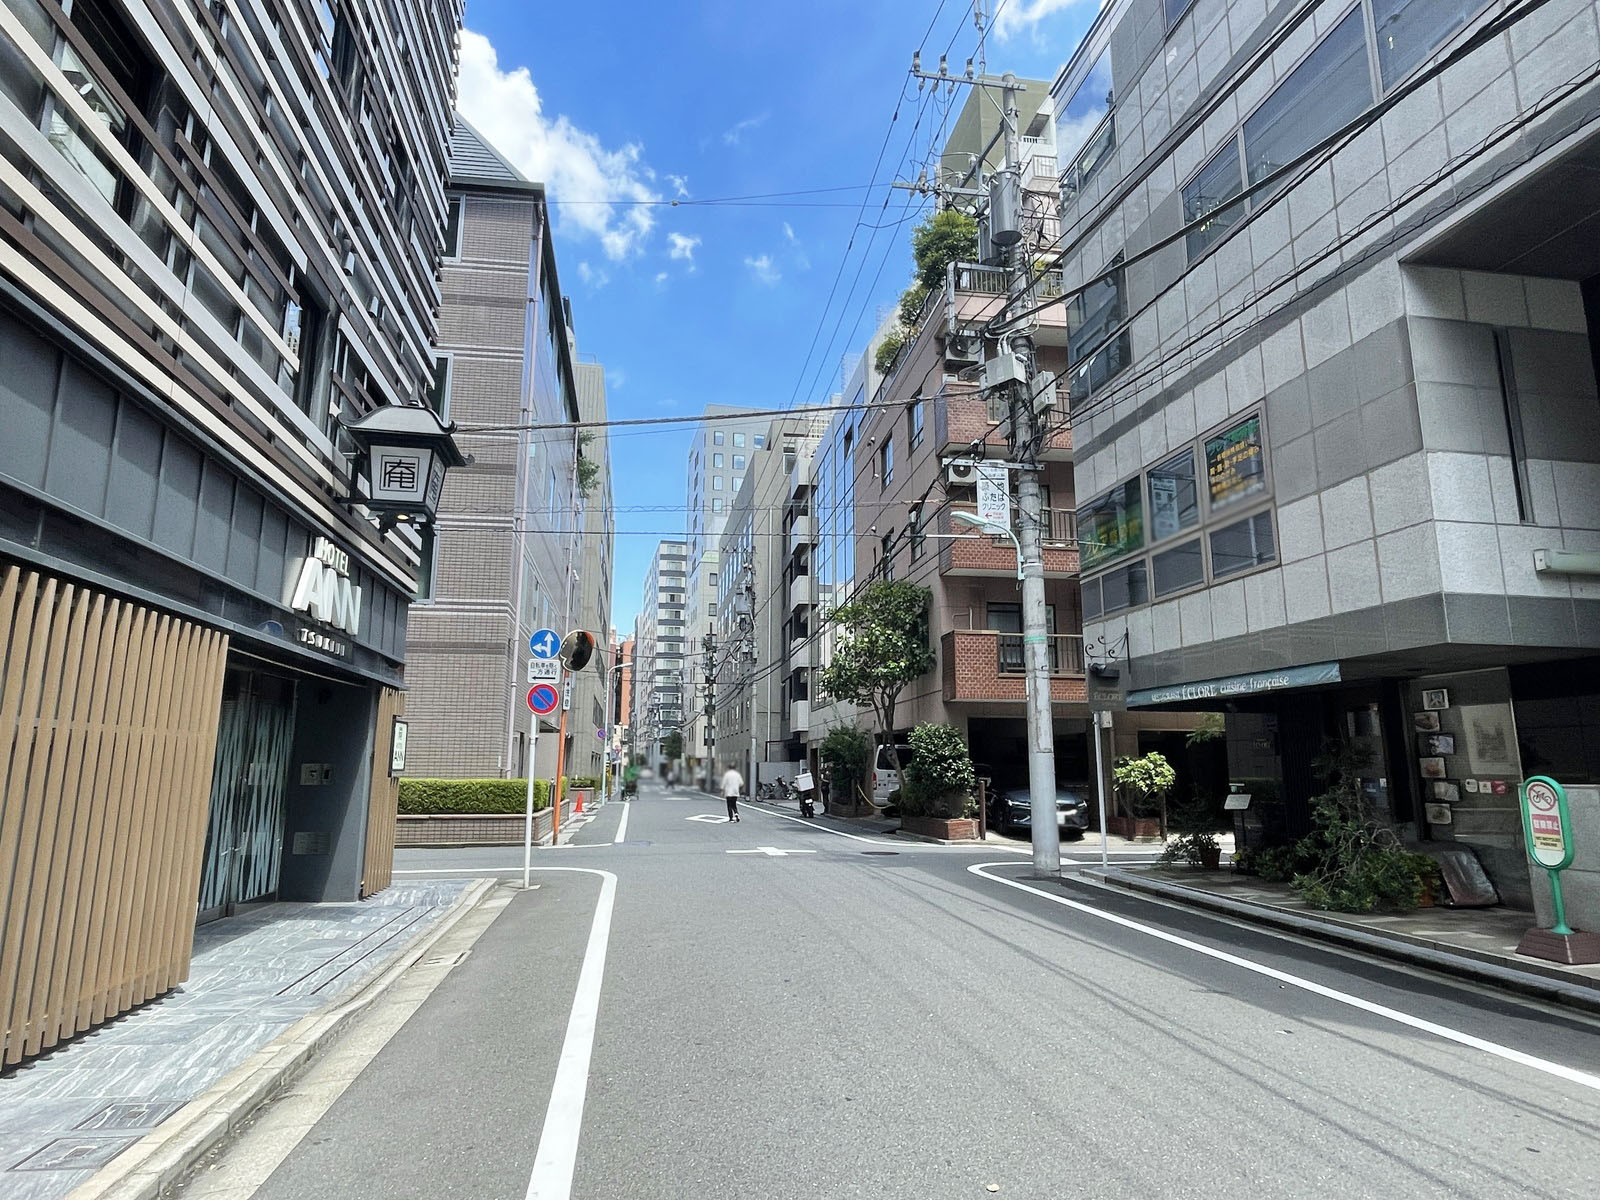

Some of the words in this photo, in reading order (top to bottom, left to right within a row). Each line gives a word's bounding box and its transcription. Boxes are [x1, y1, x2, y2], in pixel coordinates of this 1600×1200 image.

[383, 459, 416, 489] 庵
[982, 503, 1006, 511] クリニック
[314, 536, 350, 577] HOTEL
[292, 557, 362, 636] ANN
[298, 628, 346, 657] TSUKIJI
[530, 668, 558, 676] 一方通行
[1182, 685, 1217, 700] ÉCLORE
[1220, 681, 1247, 694] cuisine
[1249, 674, 1290, 692] française
